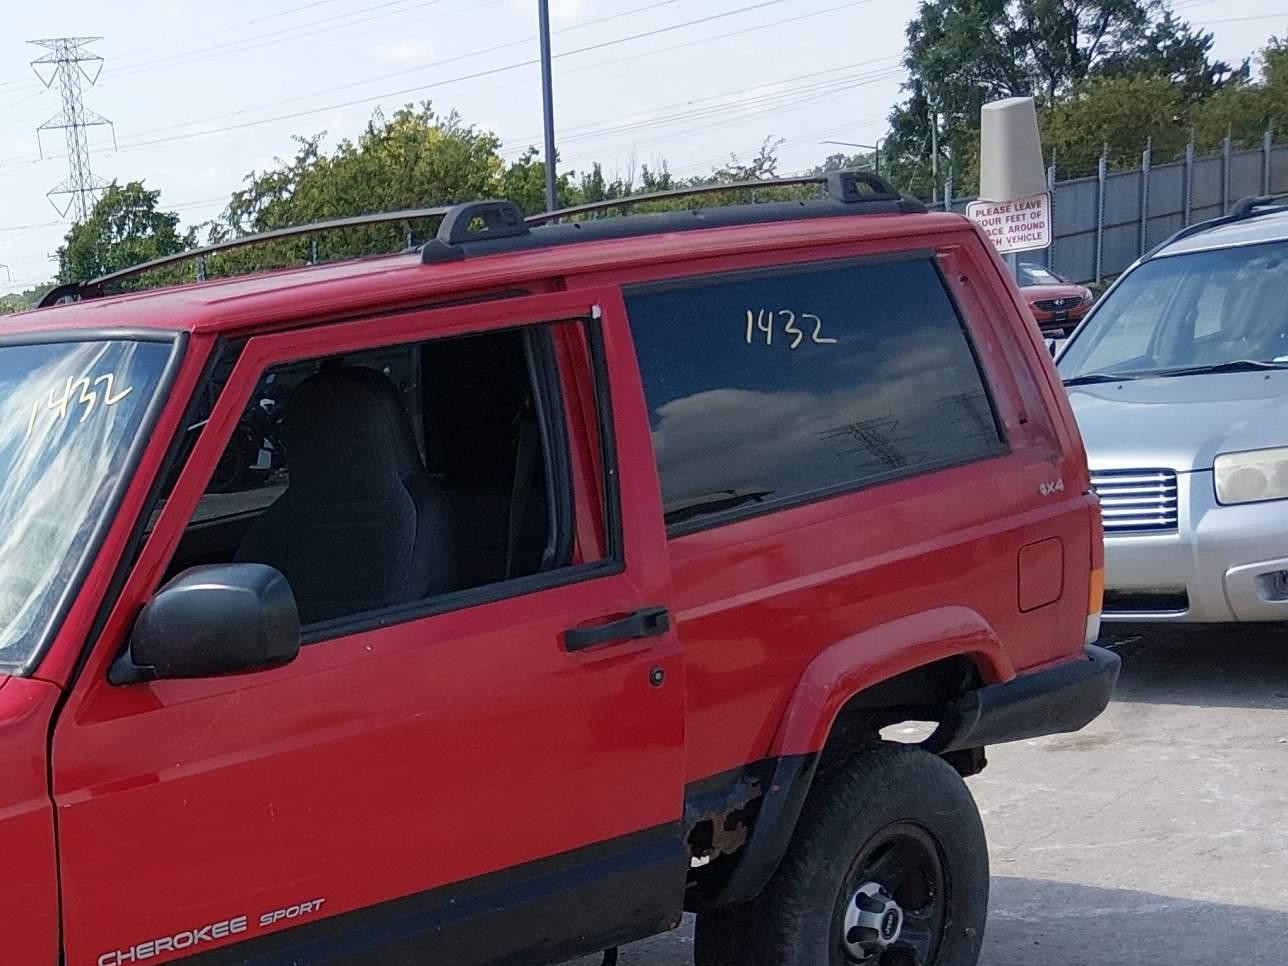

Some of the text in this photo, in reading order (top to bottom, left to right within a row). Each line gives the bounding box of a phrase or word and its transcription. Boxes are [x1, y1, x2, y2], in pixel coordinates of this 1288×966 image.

[975, 200, 1042, 218] PLEASE LEAVE
[1005, 213, 1027, 224] FEET
[1030, 210, 1042, 220] OF
[1008, 221, 1045, 234] AROUND
[1006, 232, 1043, 244] VEHICLE
[746, 309, 837, 348] 1432
[26, 373, 133, 438] 1432
[258, 898, 326, 928] SPORT
